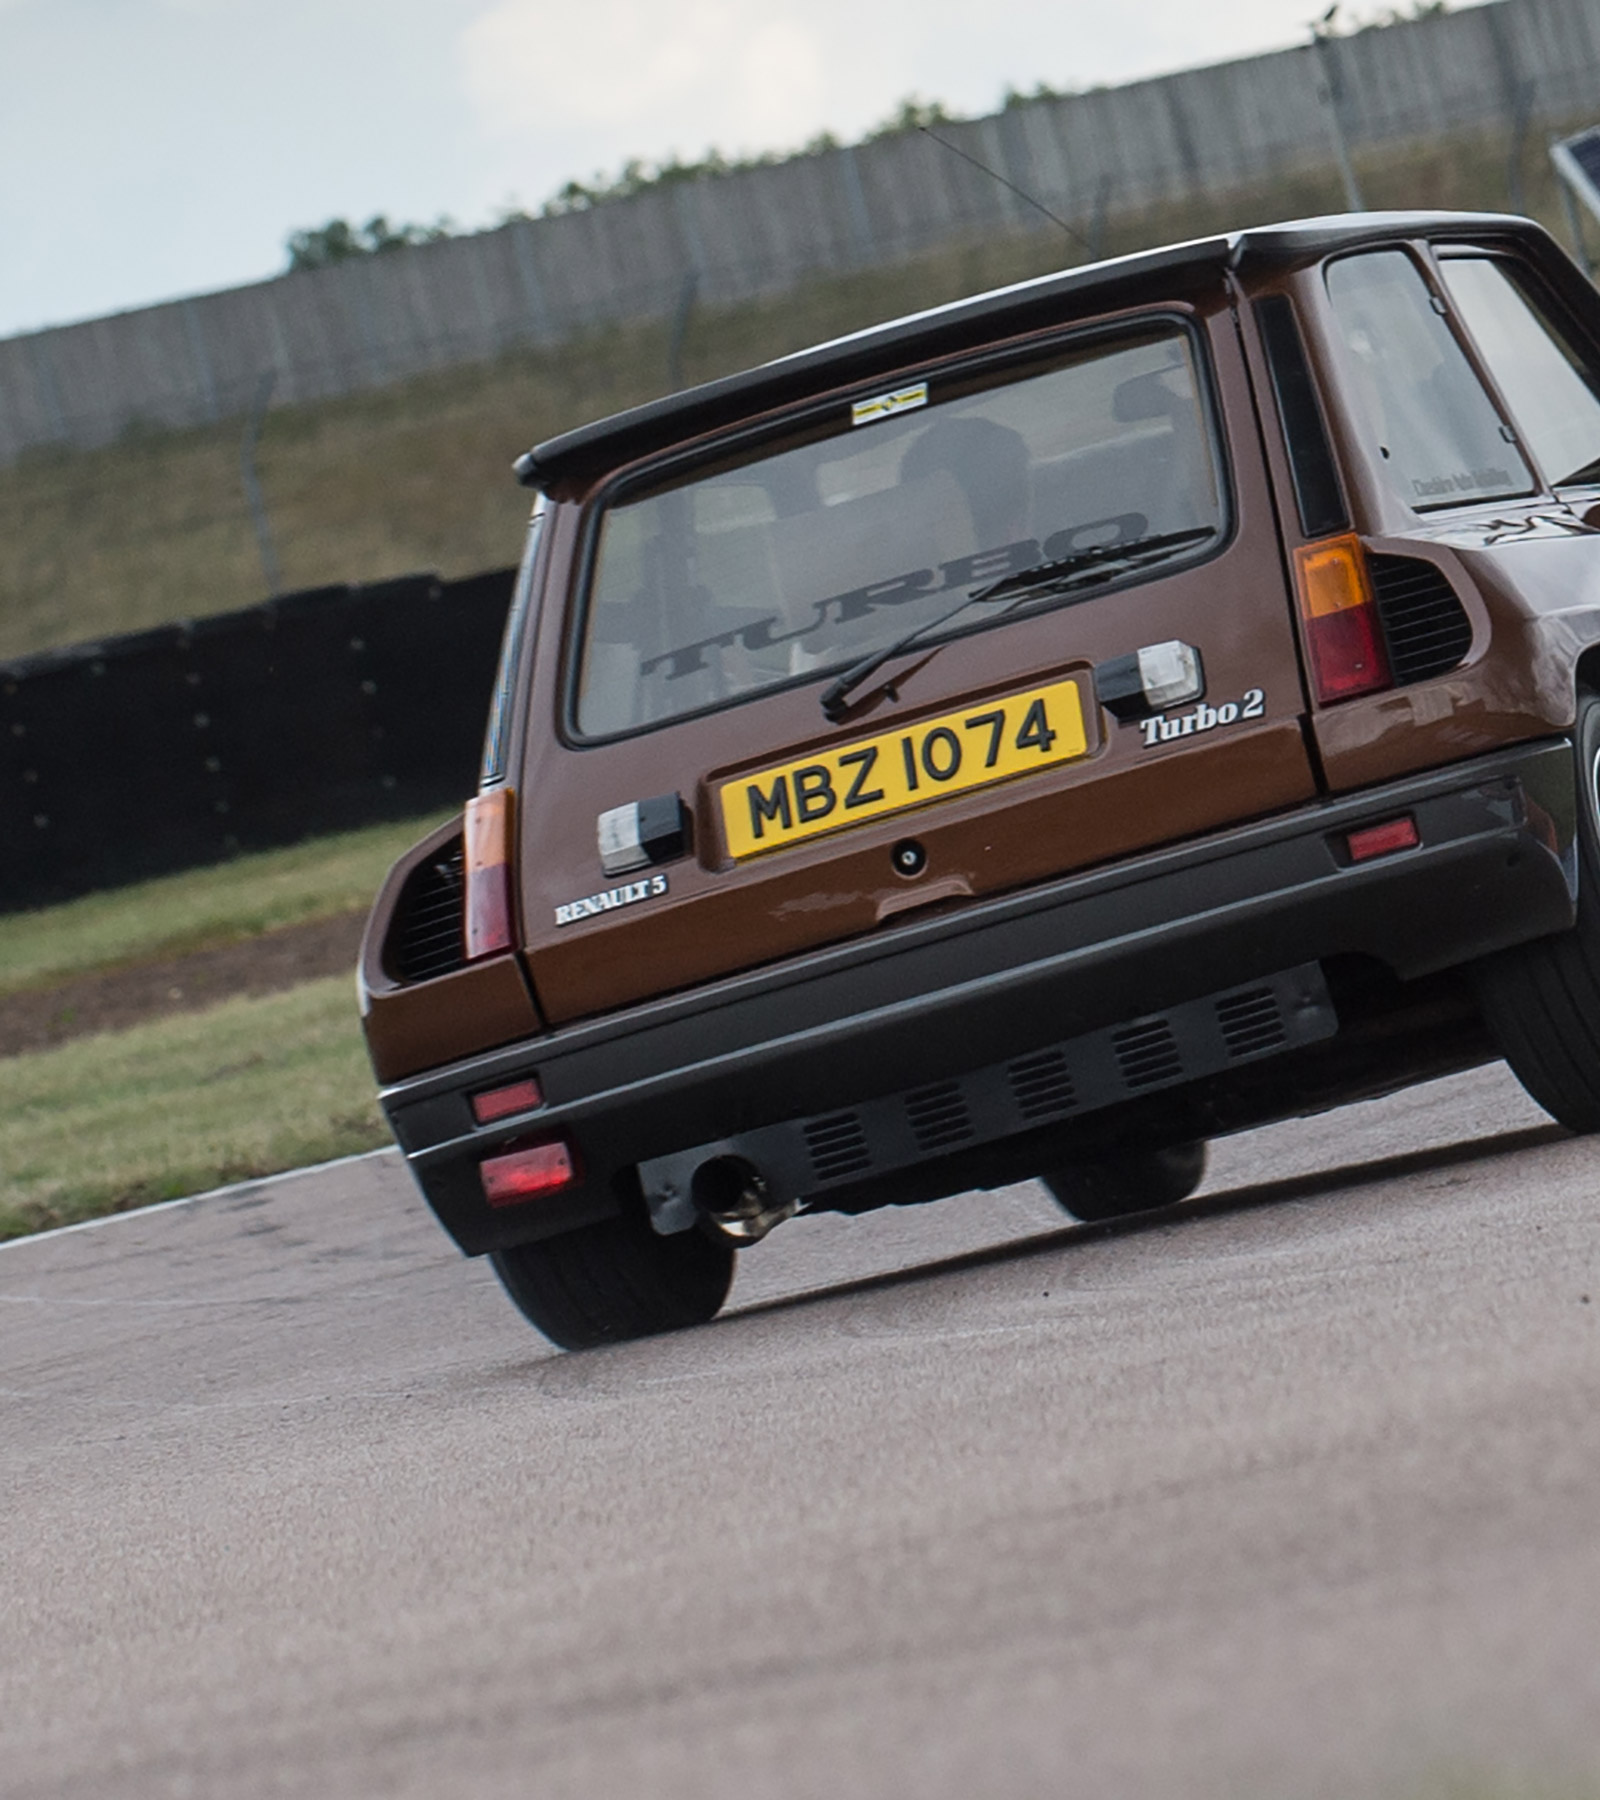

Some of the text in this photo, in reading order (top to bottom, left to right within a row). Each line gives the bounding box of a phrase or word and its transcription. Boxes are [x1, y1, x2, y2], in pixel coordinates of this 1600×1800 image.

[640, 512, 1149, 680] TURBO
[1139, 688, 1265, 746] Turbo 2
[746, 698, 1057, 839] MBZ 1074
[555, 874, 668, 925] RENAULT 5
